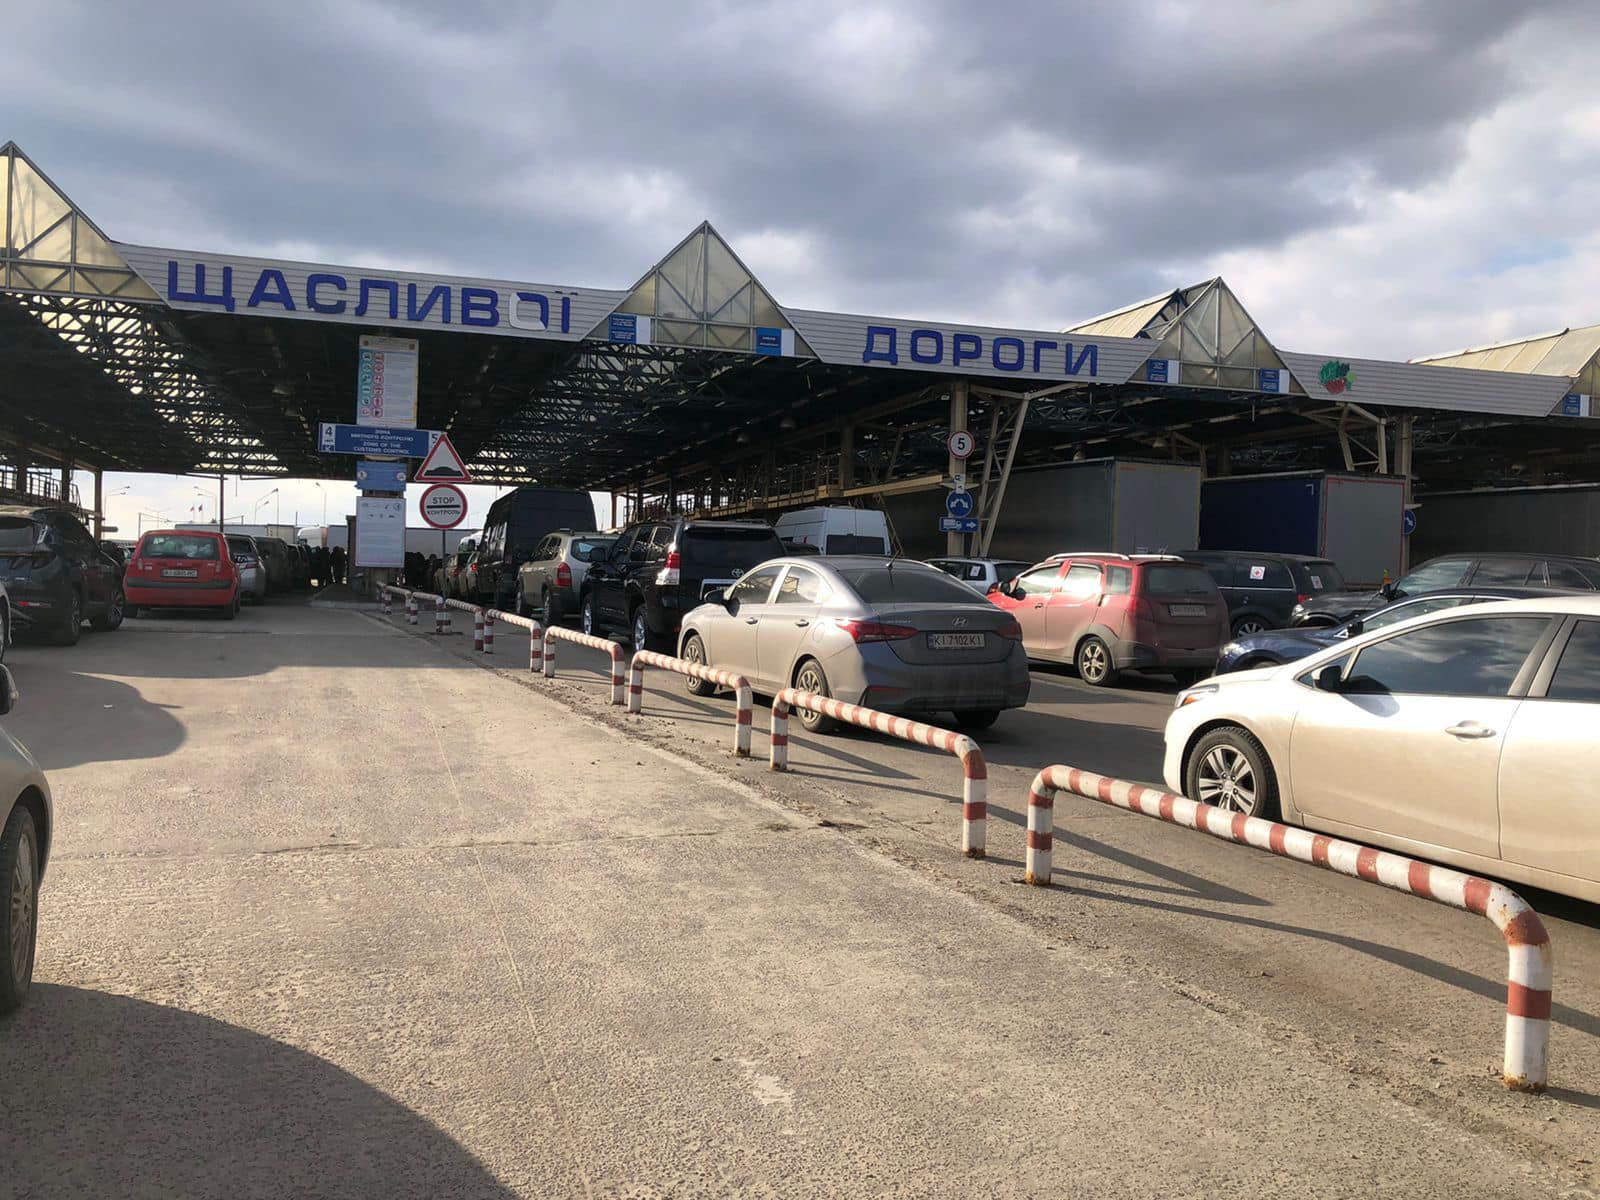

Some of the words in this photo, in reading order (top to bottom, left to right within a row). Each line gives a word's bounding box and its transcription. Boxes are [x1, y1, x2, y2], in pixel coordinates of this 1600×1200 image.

[167, 260, 579, 334] ЩАСЛИВОЇ
[862, 325, 1098, 377] ДОРОГИ
[325, 426, 333, 436] 4
[957, 437, 966, 450] 5
[431, 496, 455, 505] STOP
